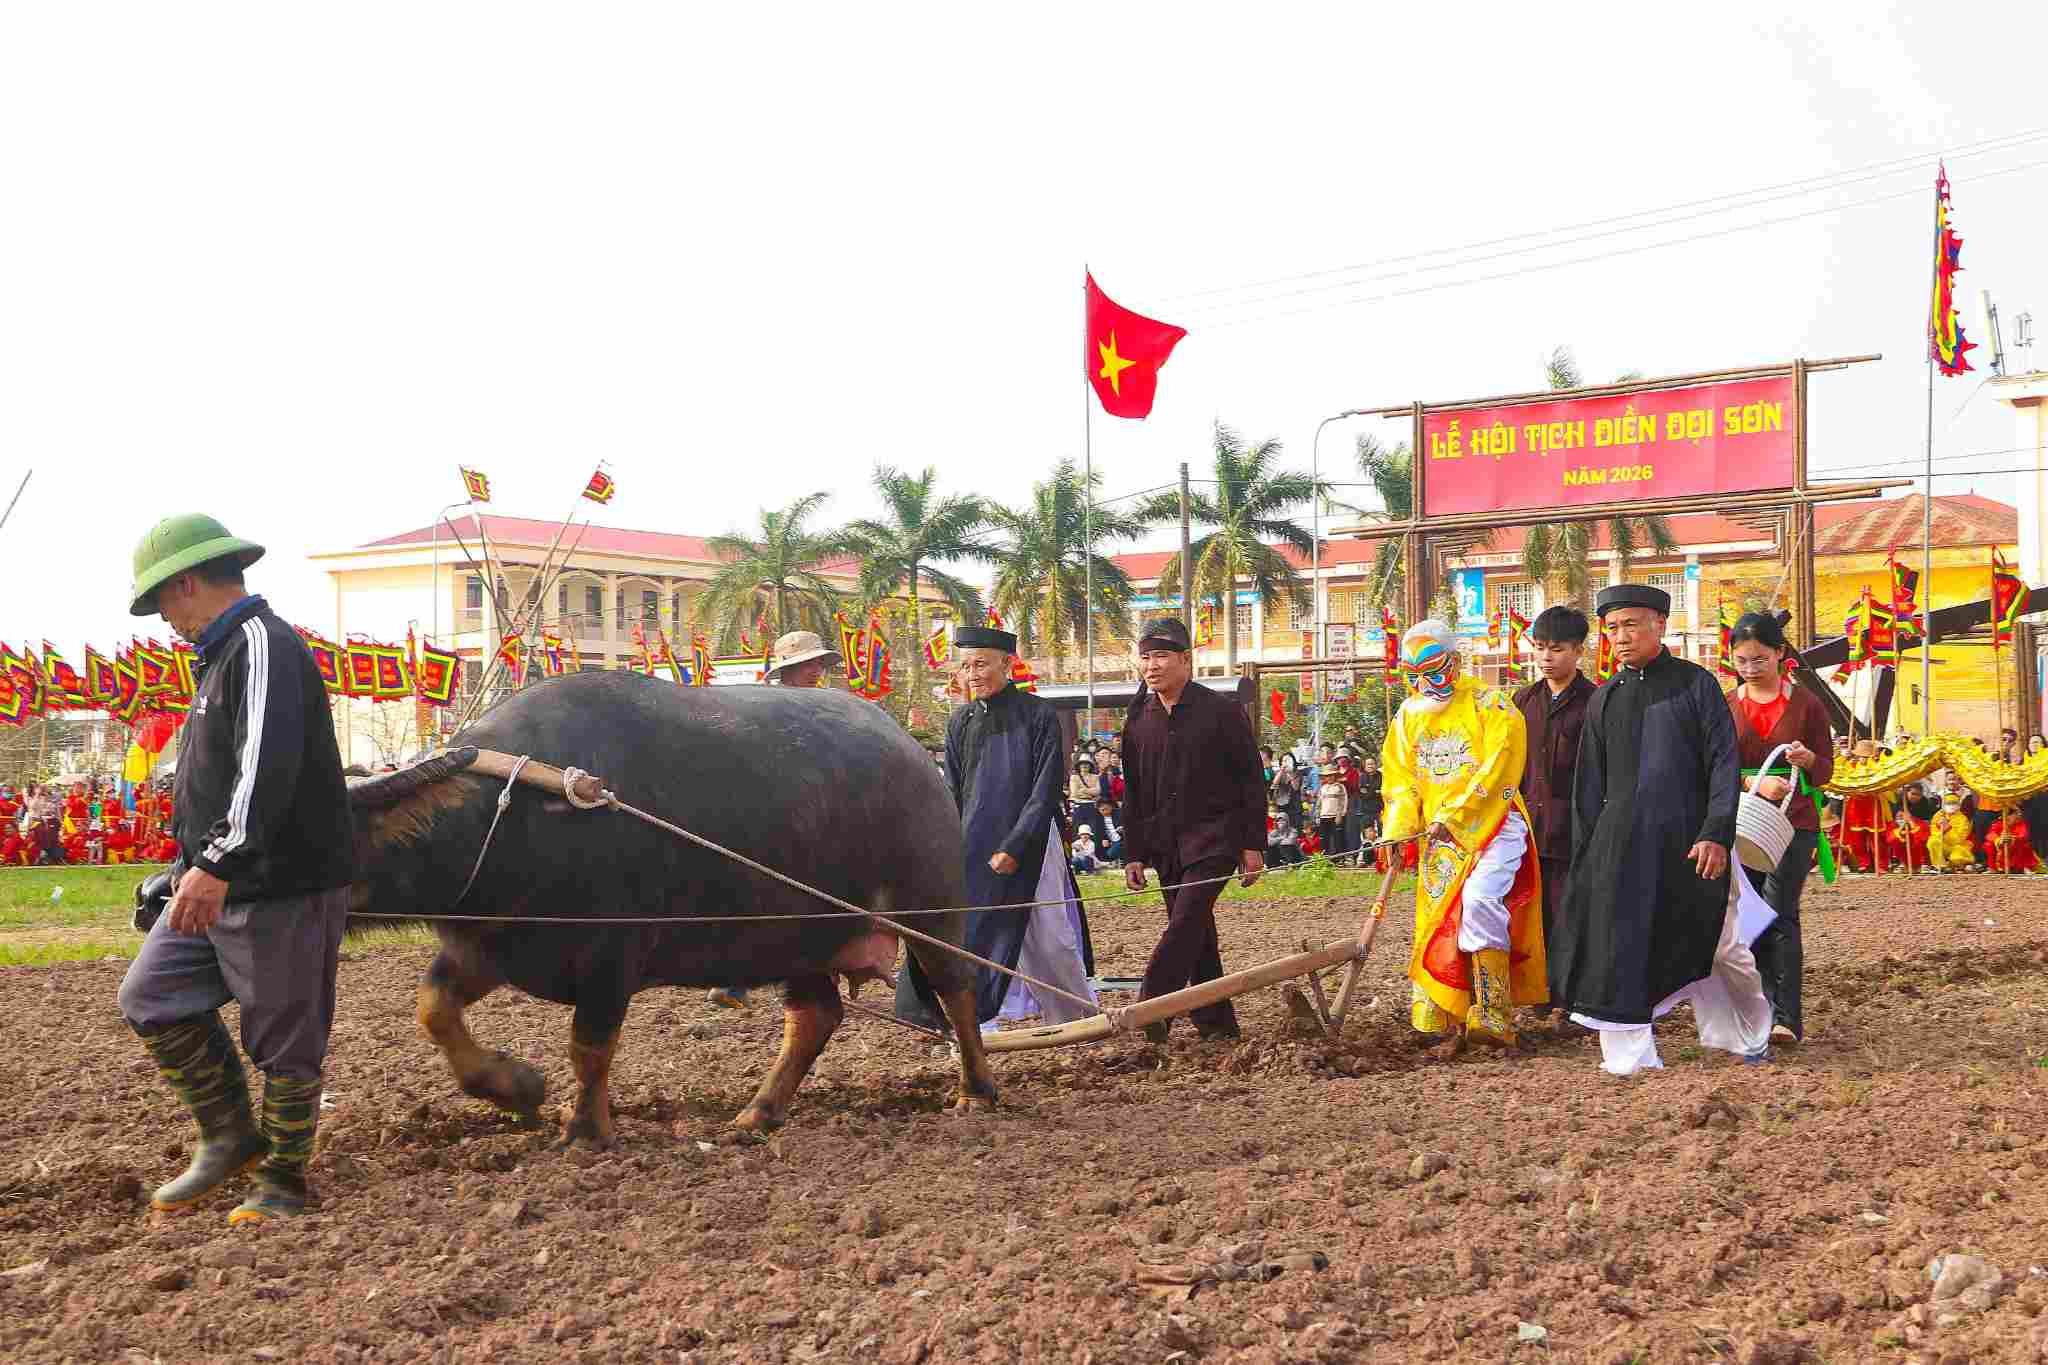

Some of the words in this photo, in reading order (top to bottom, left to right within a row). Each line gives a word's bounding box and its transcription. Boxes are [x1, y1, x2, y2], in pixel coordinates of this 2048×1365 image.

[1432, 419, 1464, 459] LỄ
[1470, 421, 1517, 463] HỘI
[1524, 420, 1585, 457] TỊCH
[1595, 405, 1657, 447] ĐIỀN
[1666, 409, 1714, 446] ĐỌI
[1723, 400, 1783, 436] SƠN
[1562, 465, 1607, 486] NĂM
[1608, 464, 1654, 483] 2026
